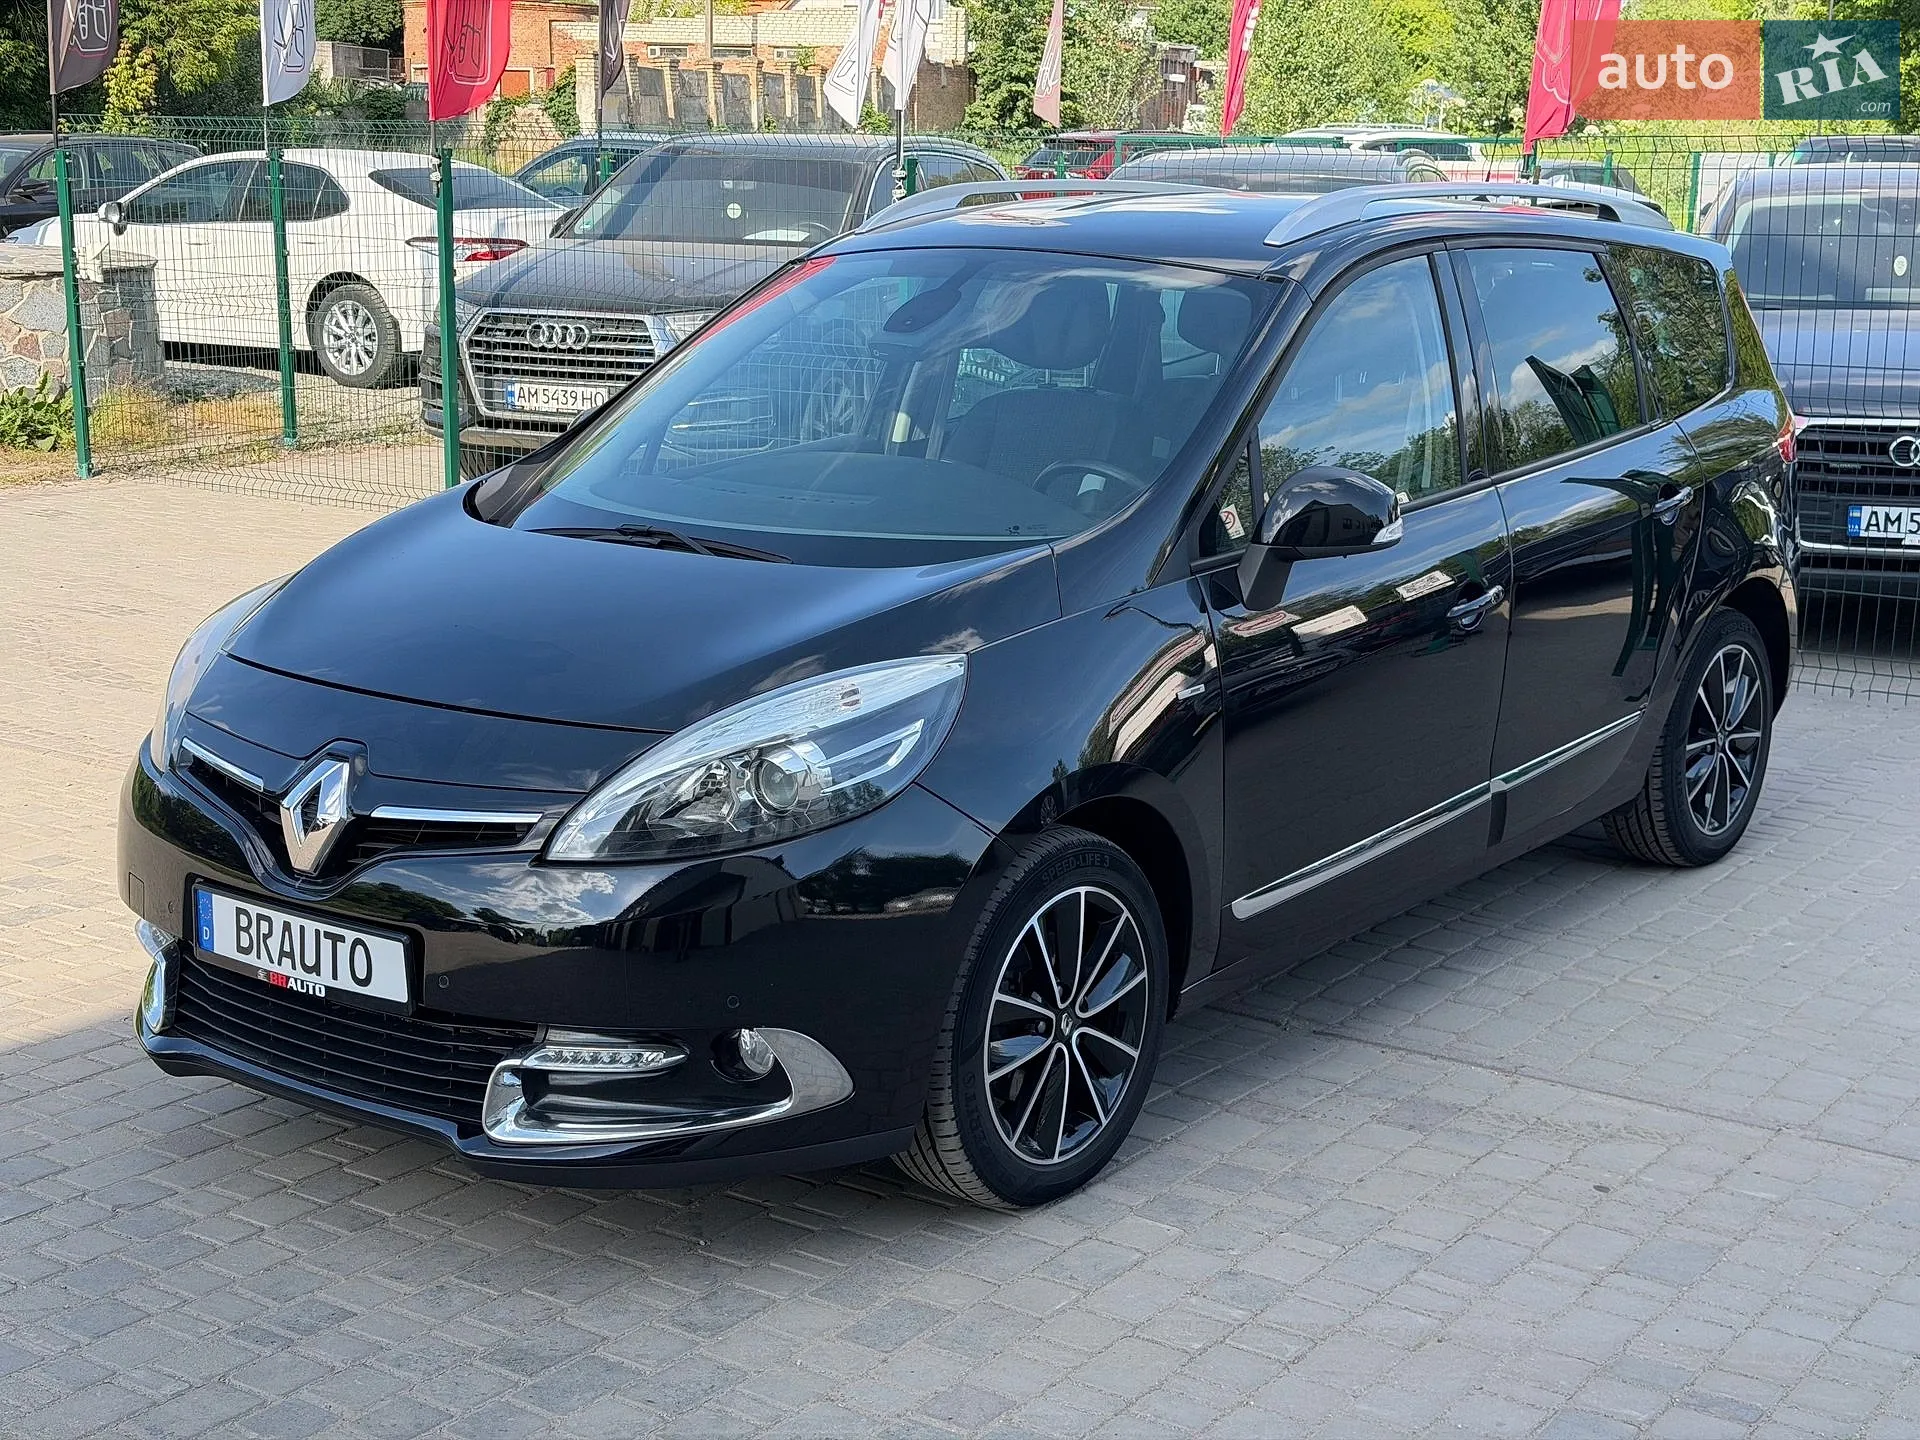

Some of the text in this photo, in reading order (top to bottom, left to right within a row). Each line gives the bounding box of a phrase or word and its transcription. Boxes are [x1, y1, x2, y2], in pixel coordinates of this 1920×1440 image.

[517, 386, 538, 403] AM
[542, 388, 578, 406] 5439
[1864, 511, 1903, 533] AM
[203, 905, 373, 988] D BRAUTO
[268, 972, 326, 998] BRAUTO
